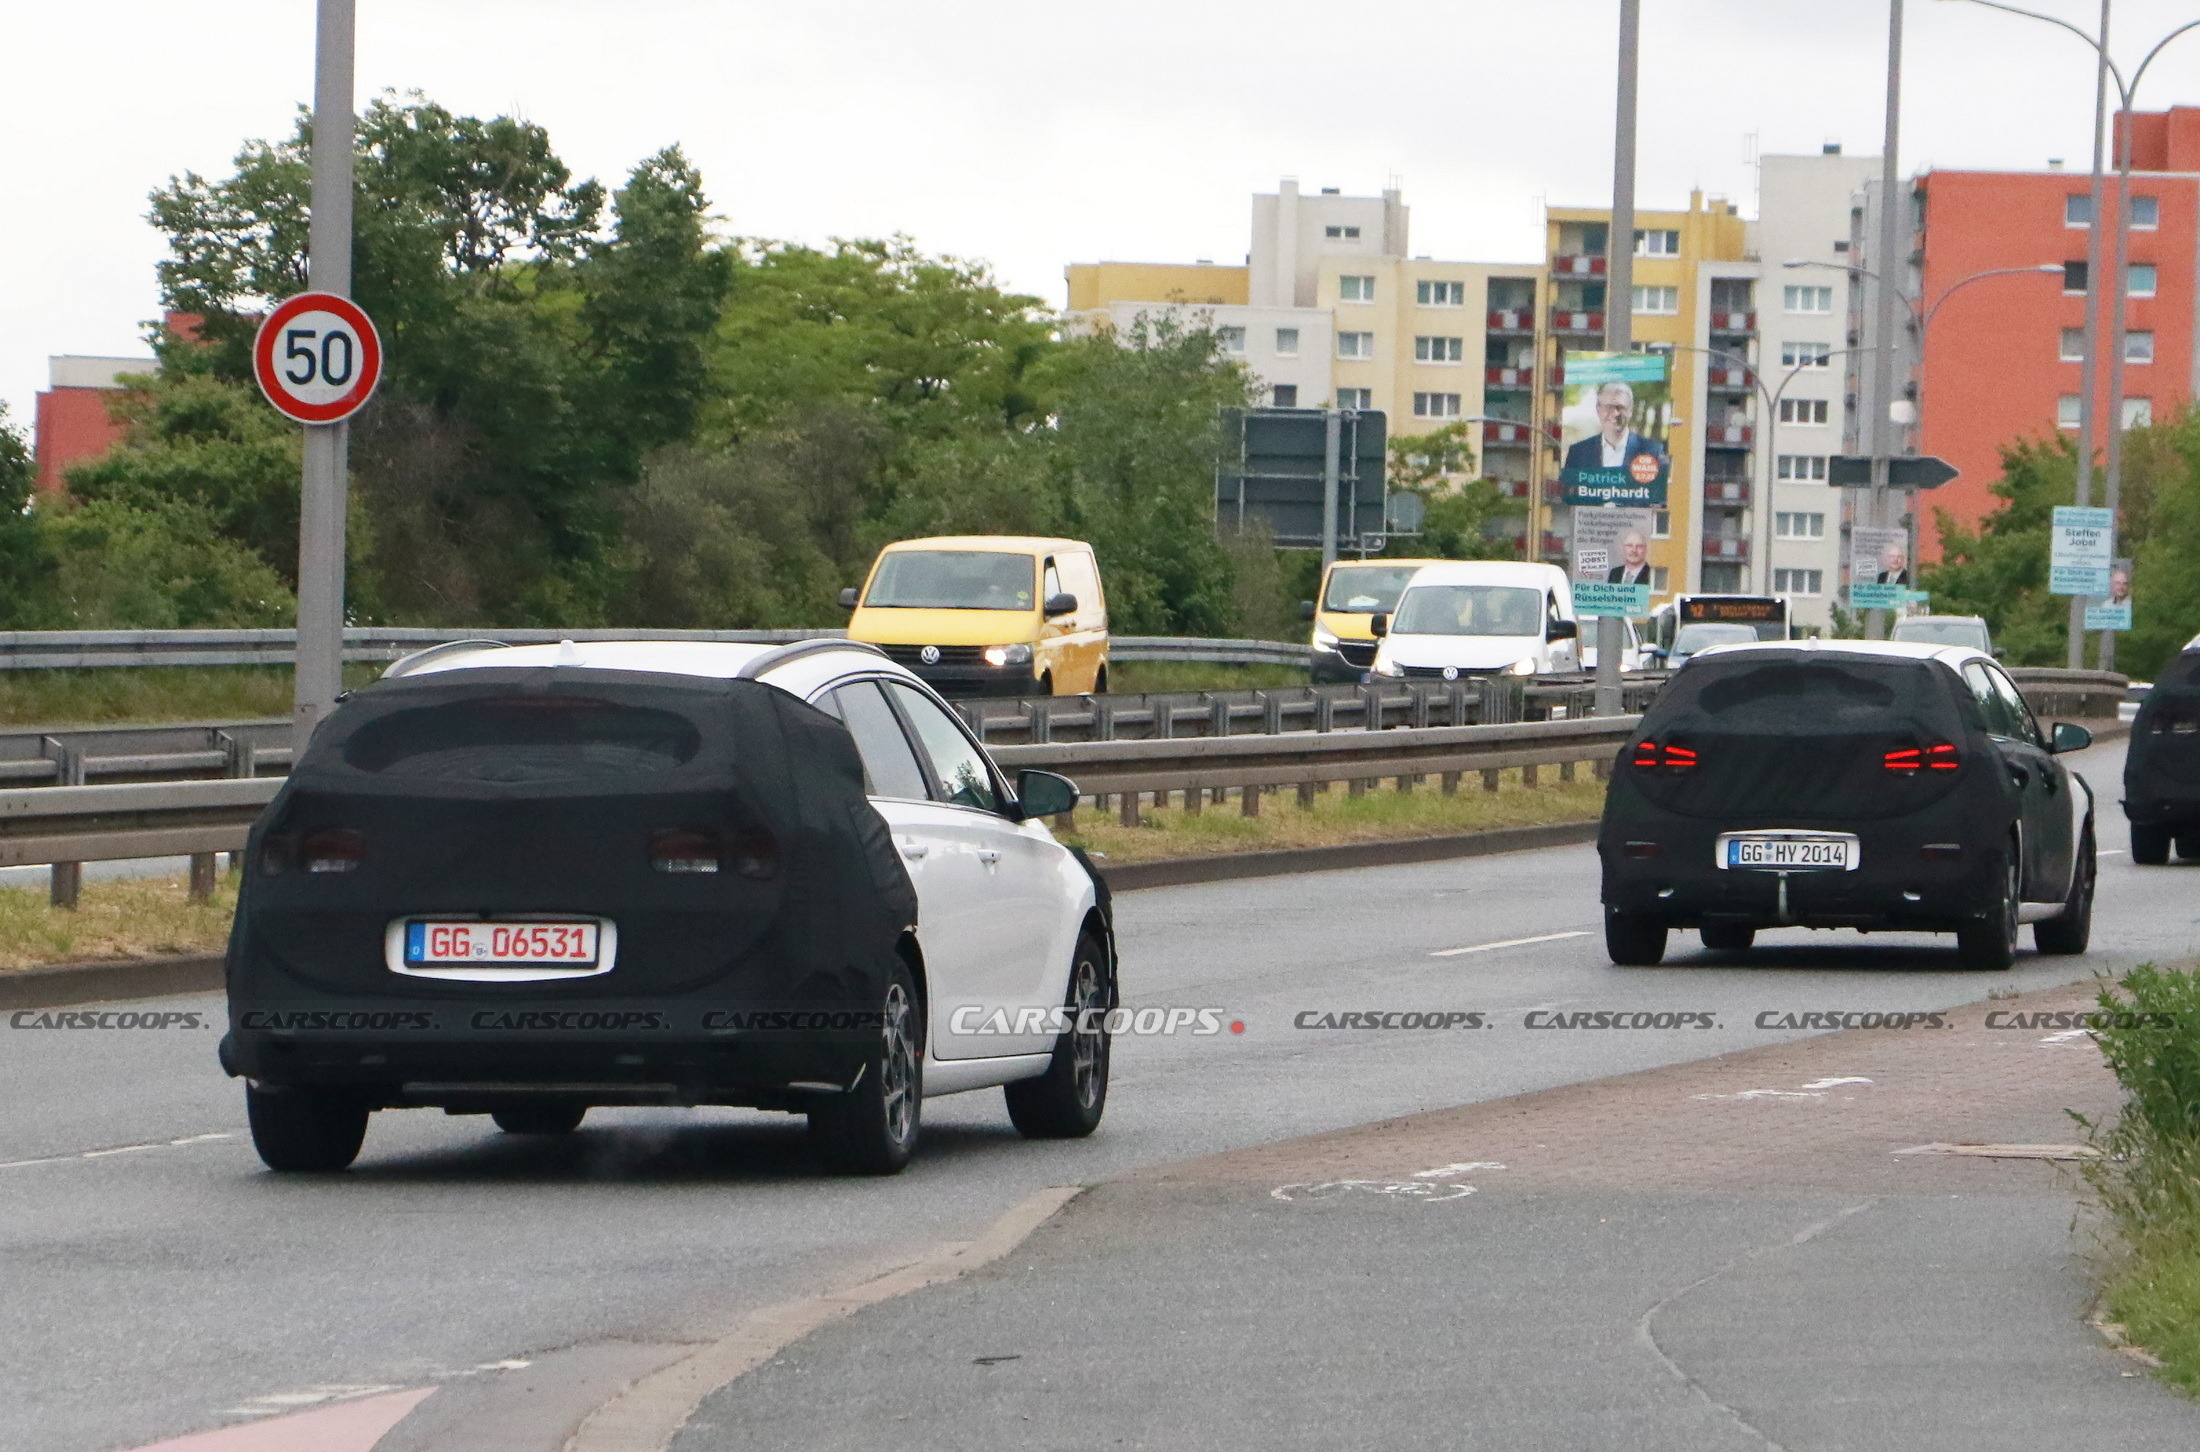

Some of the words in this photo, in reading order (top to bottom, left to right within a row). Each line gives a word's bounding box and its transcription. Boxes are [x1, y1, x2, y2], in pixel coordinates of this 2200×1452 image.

[286, 329, 352, 386] 50
[1578, 471, 1627, 484] Patrick
[1578, 486, 1650, 500] Burghardt
[1574, 583, 1590, 592] Für
[1593, 584, 1615, 593] Dich
[1617, 586, 1636, 594] und
[1574, 593, 1636, 604] Rüsselsheim
[1741, 844, 1762, 862] GG
[1776, 845, 1797, 863] HY
[1801, 845, 1843, 863] 2014
[430, 927, 470, 958] GG
[492, 927, 587, 959] 06531
